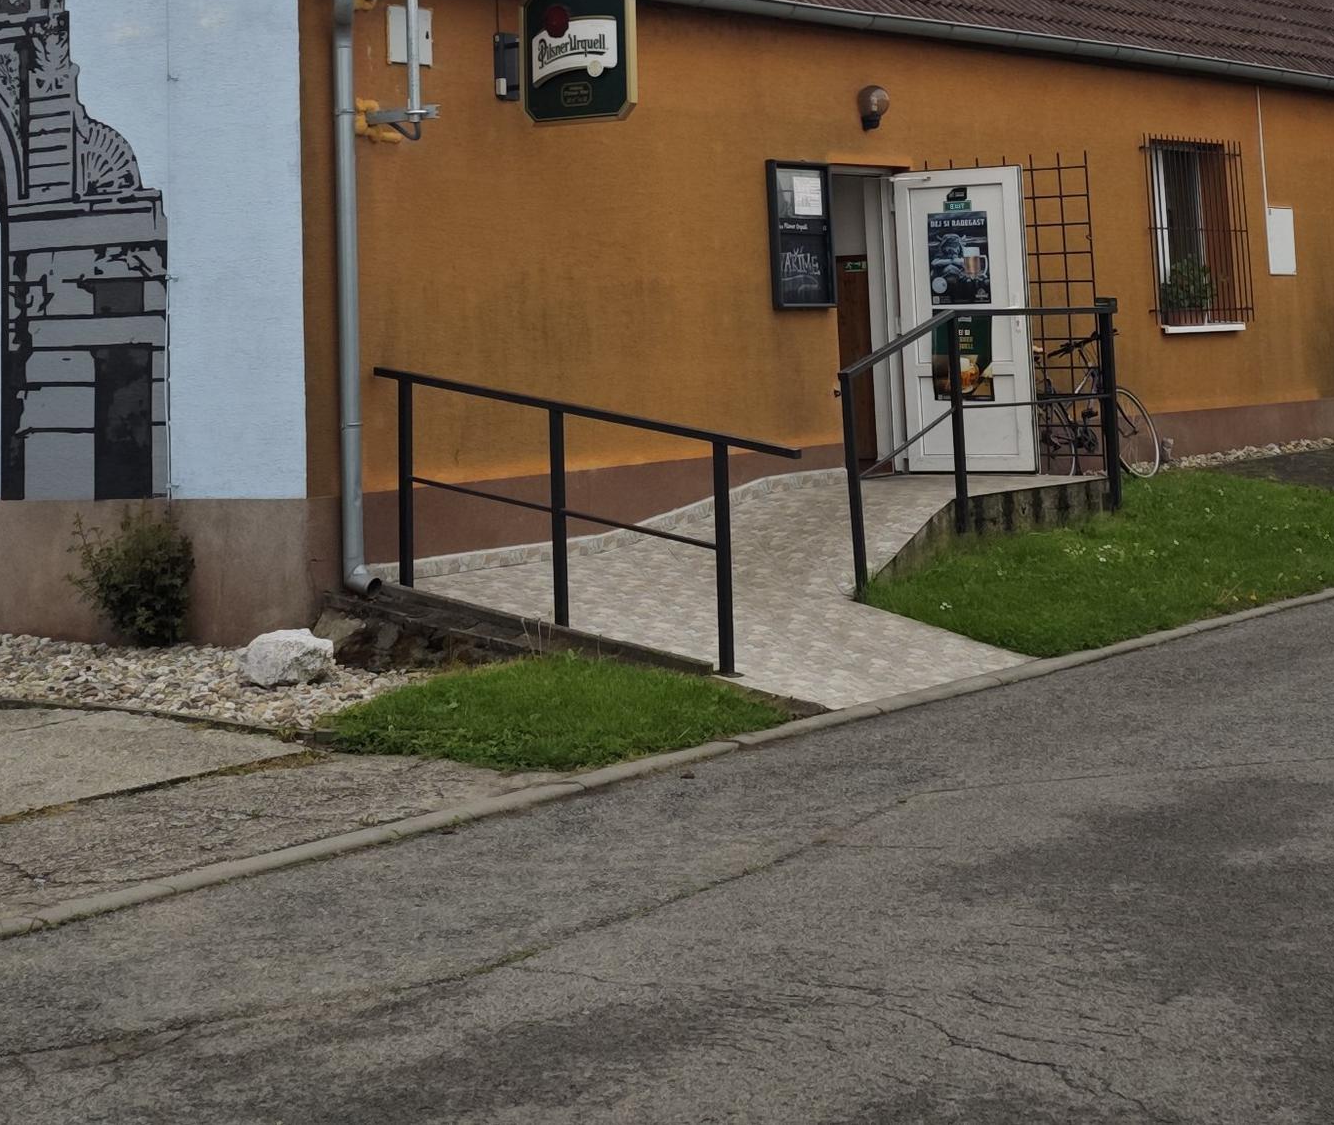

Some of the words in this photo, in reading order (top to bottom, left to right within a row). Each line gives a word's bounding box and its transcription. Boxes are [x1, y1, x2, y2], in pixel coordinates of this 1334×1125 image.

[538, 38, 569, 69] Pilsner
[568, 34, 606, 57] Urquell
[951, 218, 985, 227] RADEGAST
